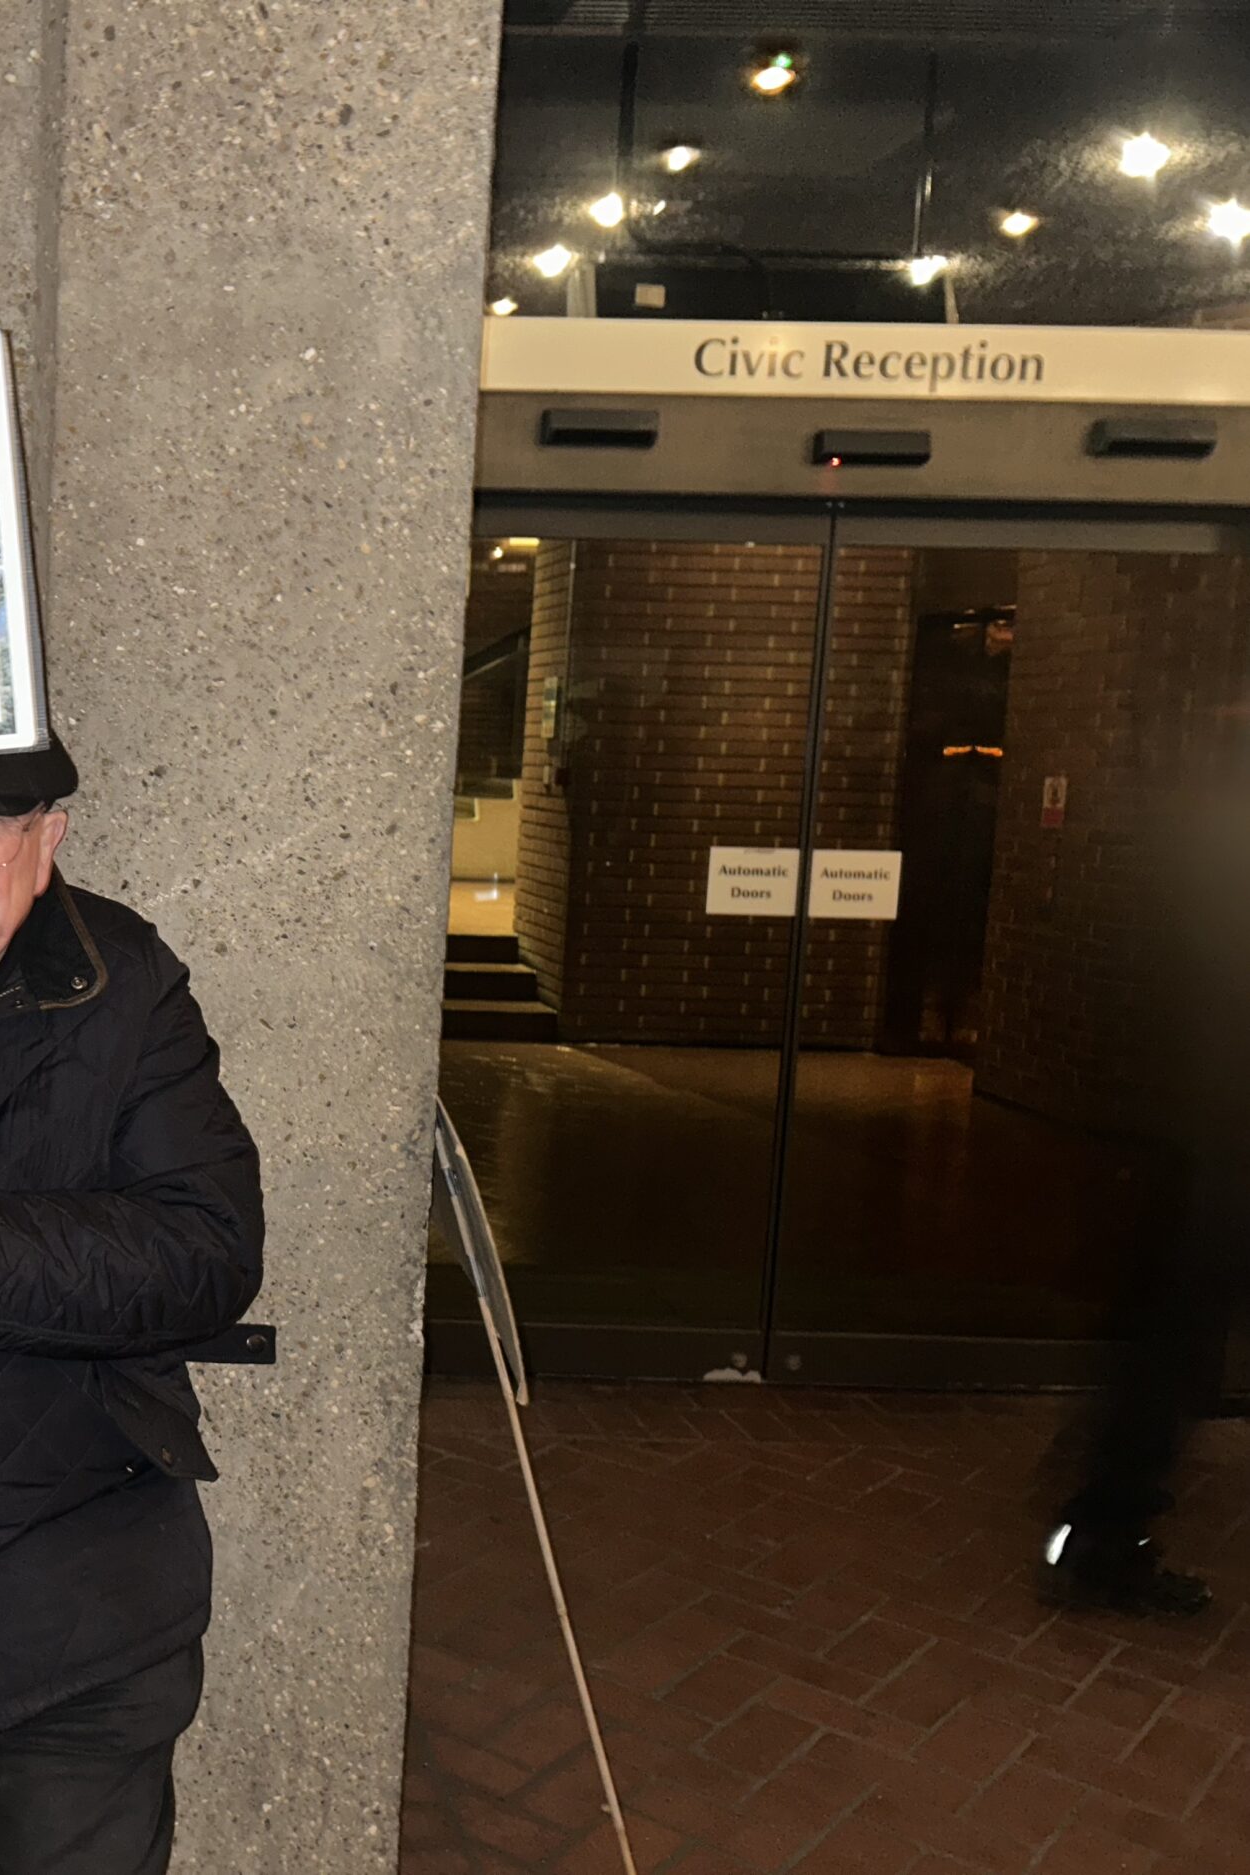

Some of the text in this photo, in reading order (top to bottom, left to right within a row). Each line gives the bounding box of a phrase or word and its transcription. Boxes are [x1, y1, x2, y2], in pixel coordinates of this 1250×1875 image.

[693, 336, 1045, 393] Civic Reception
[718, 864, 789, 879] Automatic
[820, 867, 891, 881] Automatic
[730, 886, 772, 900] Doors
[831, 889, 874, 903] Doors
